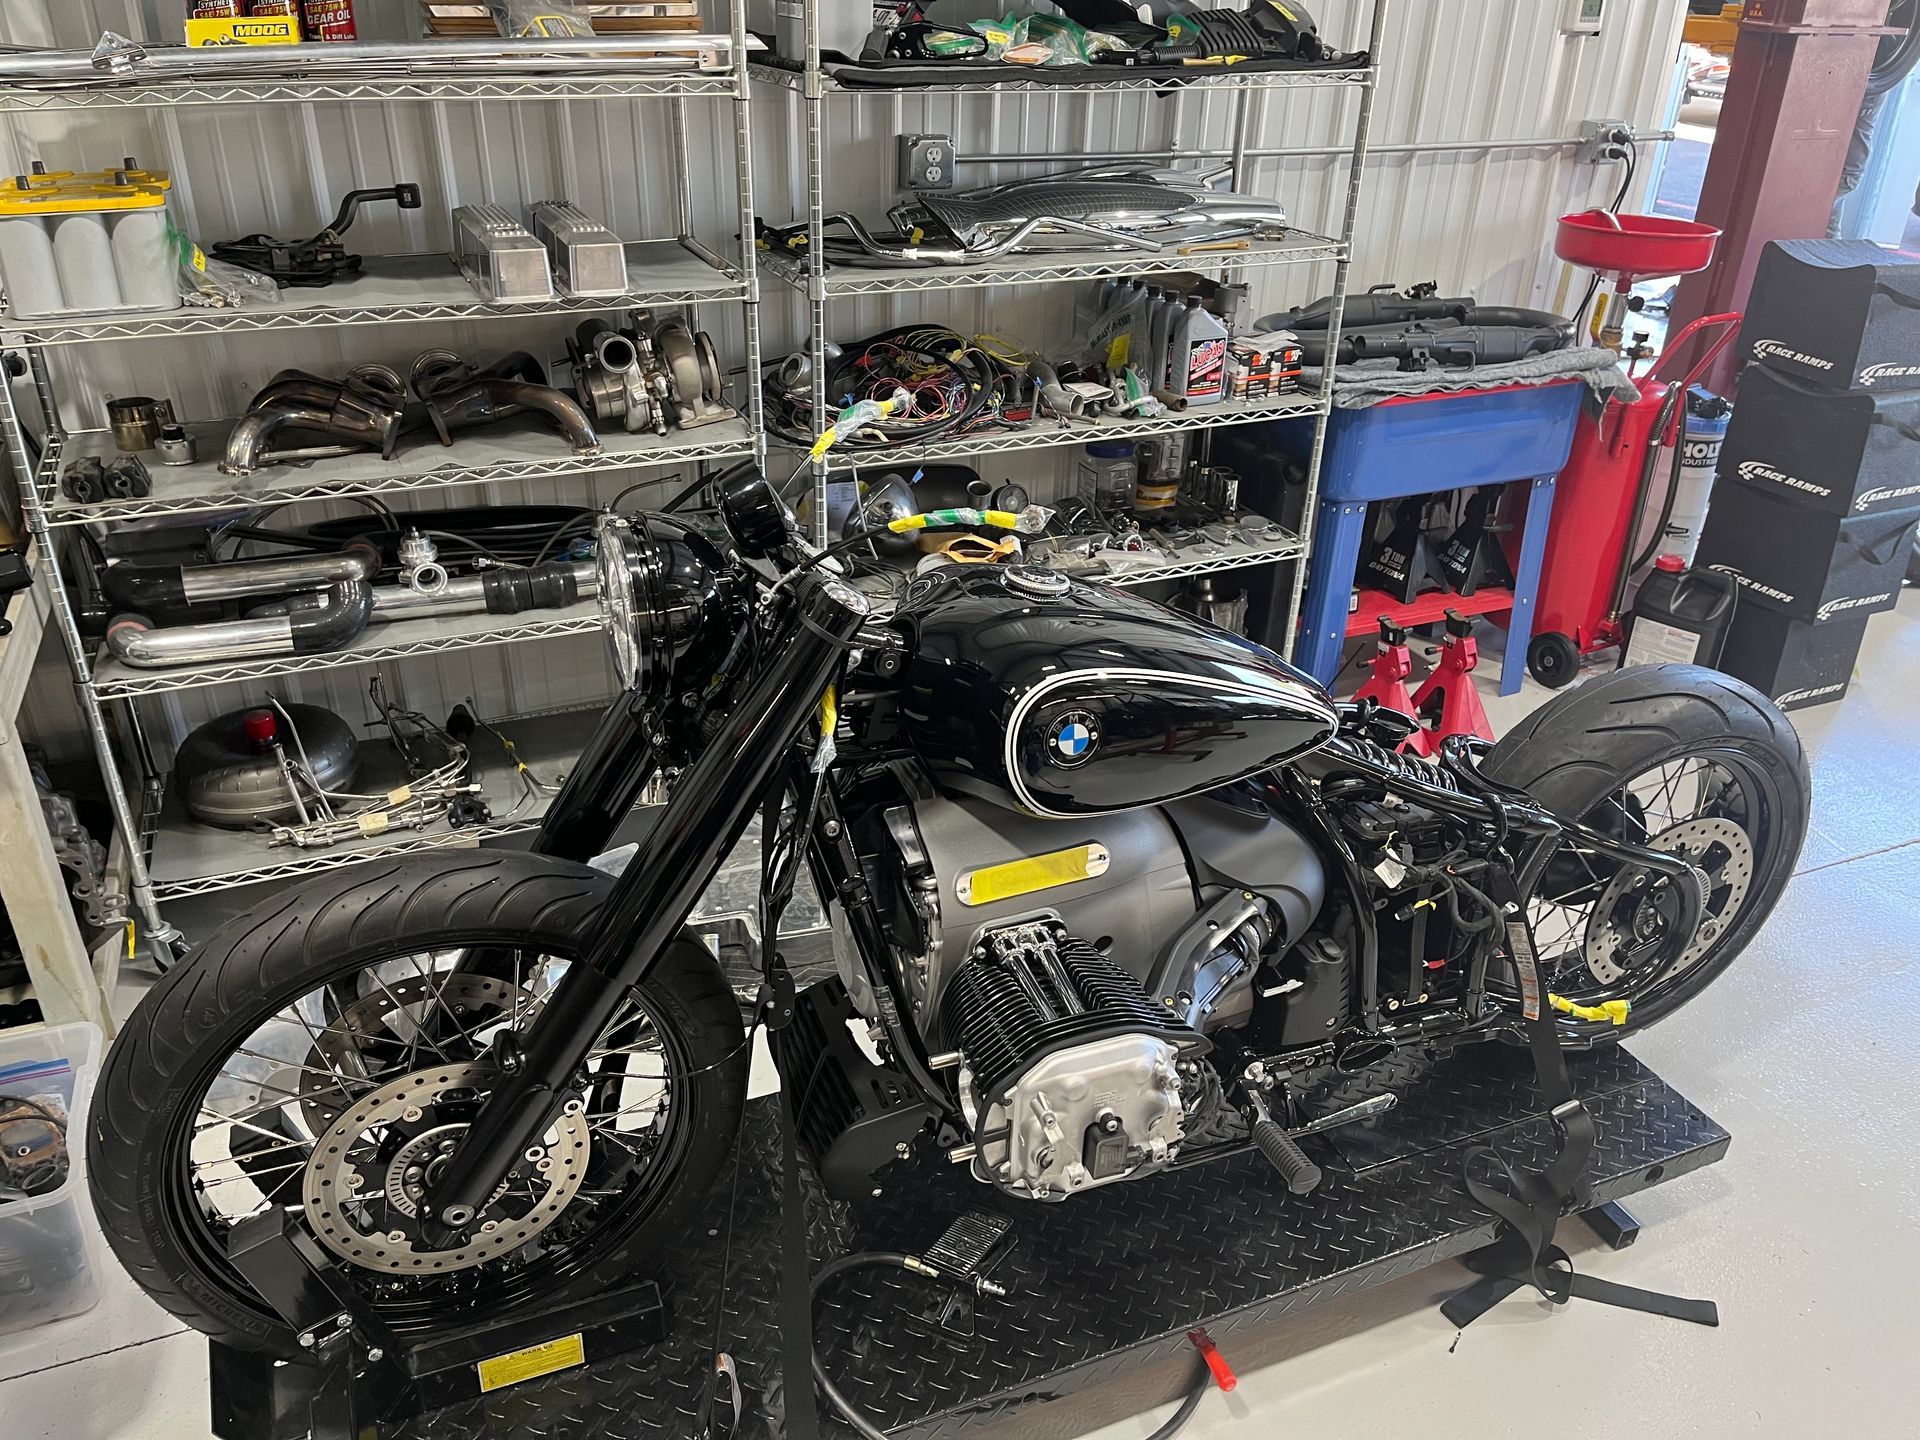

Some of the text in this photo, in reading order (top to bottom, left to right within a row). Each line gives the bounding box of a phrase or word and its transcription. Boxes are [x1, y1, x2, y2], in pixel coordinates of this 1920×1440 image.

[307, 10, 350, 25] GEAR OIL
[310, 4, 322, 13] SAE
[236, 24, 287, 37] MOOG
[1190, 340, 1225, 369] LUCAS
[1766, 344, 1834, 370] RACE RAMPS
[1874, 367, 1907, 377] RACE
[1753, 466, 1832, 497] RACE RAMPS
[1867, 490, 1894, 502] RACE
[1380, 546, 1406, 564] 3 TON
[1448, 540, 1460, 555] 3
[1368, 560, 1405, 581] DAYTONA
[1750, 582, 1794, 603] RAMPS
[1829, 593, 1892, 612] RACE RAMPS
[1784, 683, 1845, 703] RACE RAMPS
[1053, 714, 1095, 733] BMW
[521, 1343, 553, 1356] WARNNG
